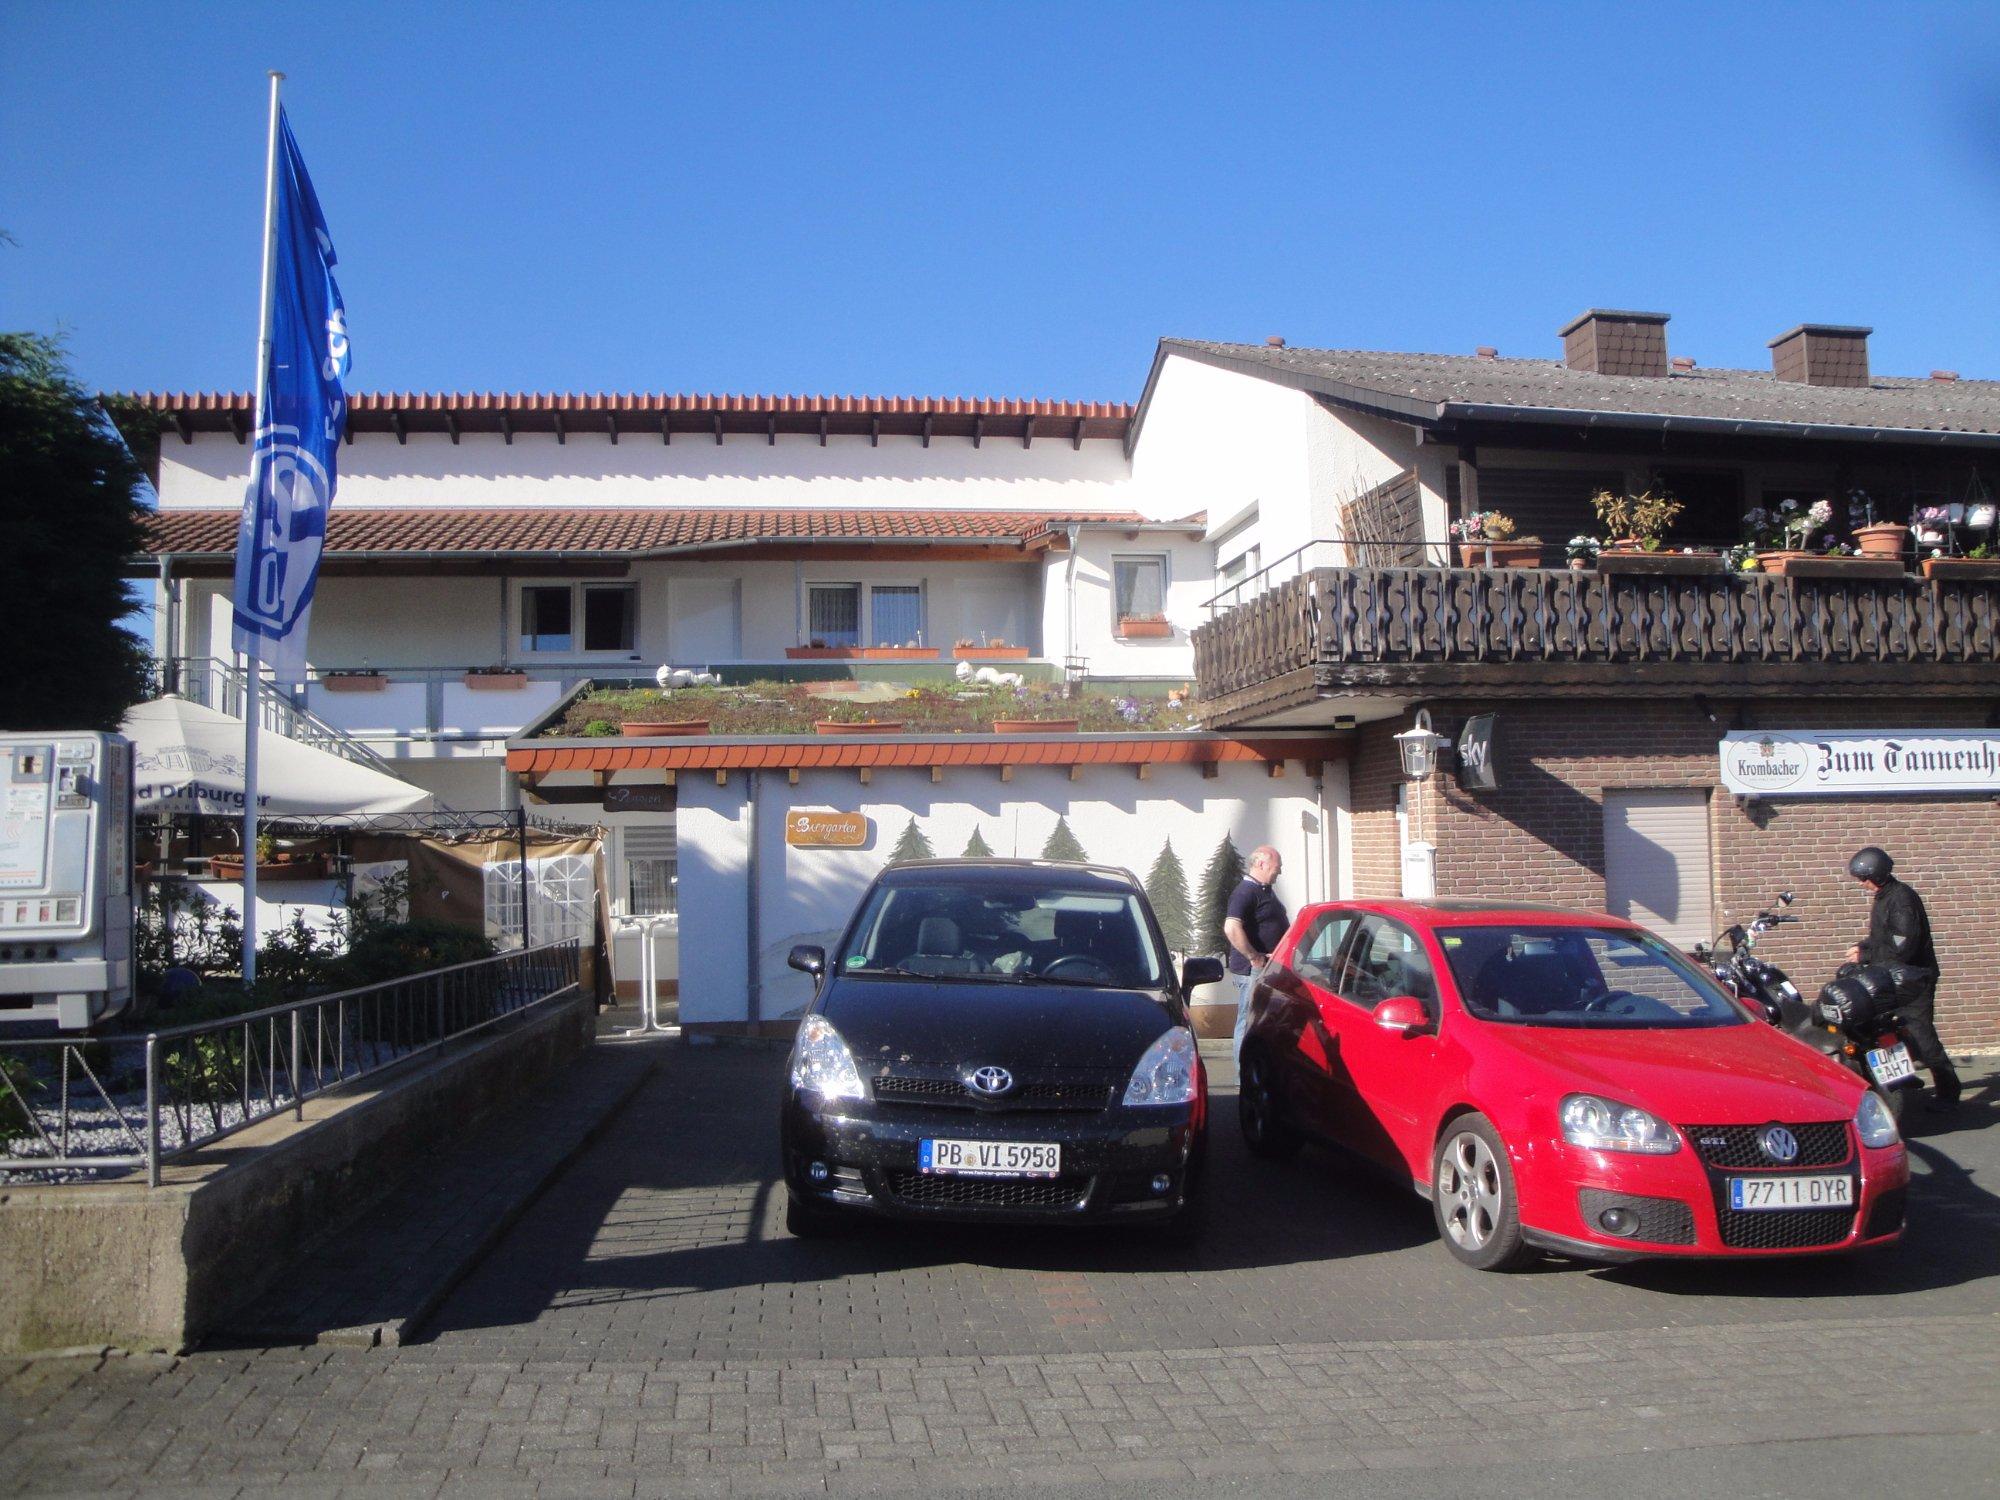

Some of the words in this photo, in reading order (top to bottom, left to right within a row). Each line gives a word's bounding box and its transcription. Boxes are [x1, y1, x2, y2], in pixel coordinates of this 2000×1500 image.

[1459, 733, 1488, 774] sky
[1816, 742, 1875, 781] Zum
[1883, 741, 2000, 778] Tannenh
[1737, 759, 1800, 776] Krombacher
[160, 781, 271, 809] Driburgr
[796, 817, 857, 840] Biergarten
[1700, 1137, 1728, 1145] GTI
[937, 1143, 962, 1165] PB
[1748, 1181, 1801, 1204] 7711
[1810, 1179, 1847, 1202] DYR
